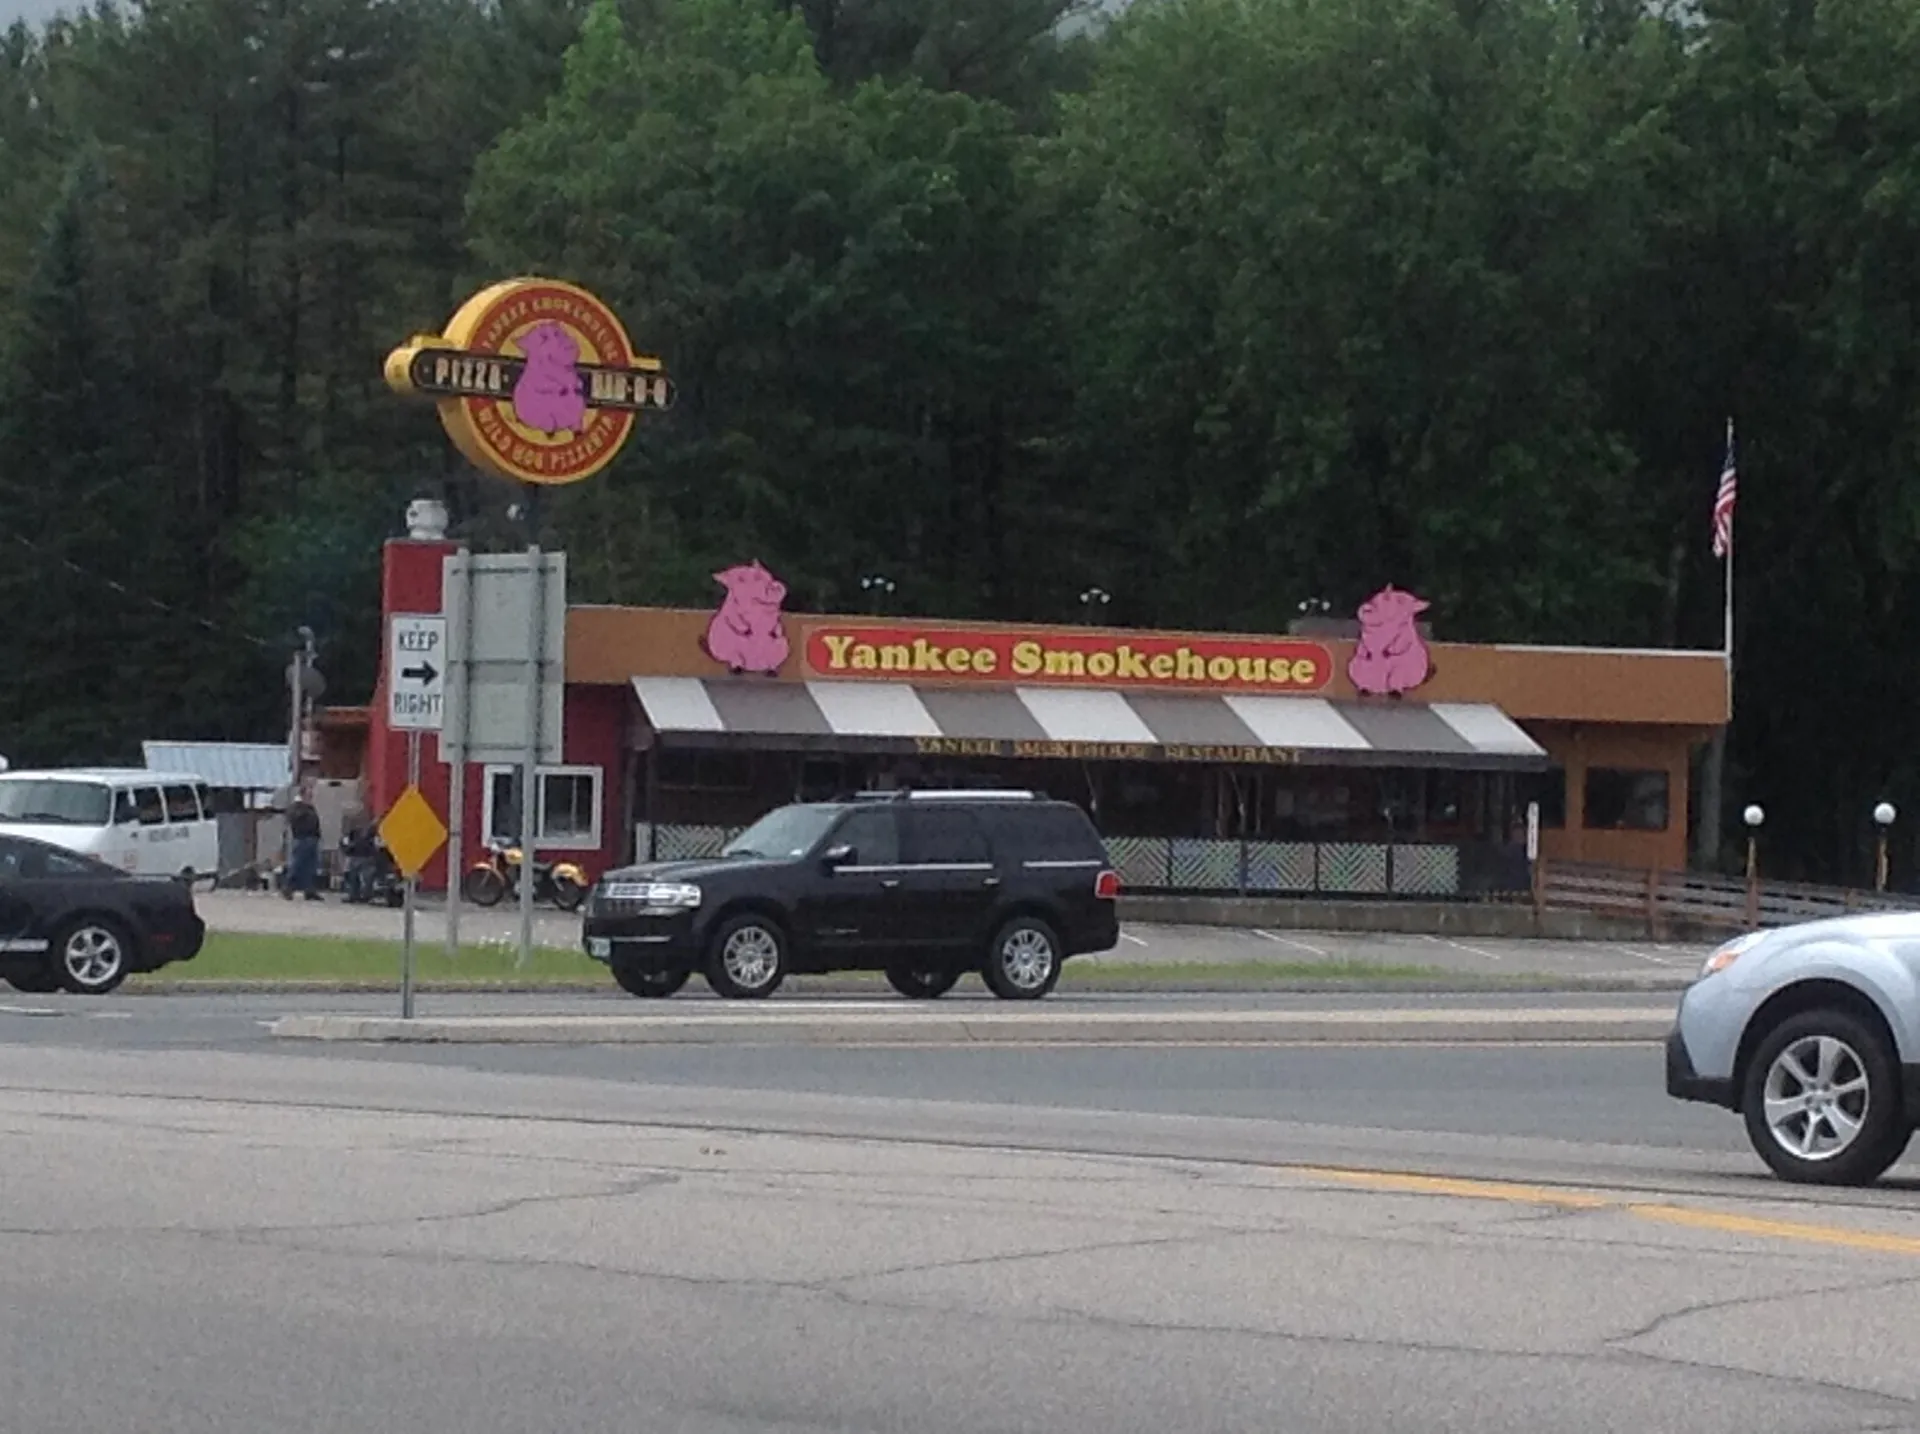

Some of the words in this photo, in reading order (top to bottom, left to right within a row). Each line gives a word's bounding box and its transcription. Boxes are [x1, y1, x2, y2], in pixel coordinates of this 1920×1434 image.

[435, 357, 501, 390] PIZZA
[398, 630, 439, 651] KEEP
[822, 634, 997, 674] Yankee
[1011, 640, 1317, 684] Smokehouse
[394, 692, 442, 714] RIGHT
